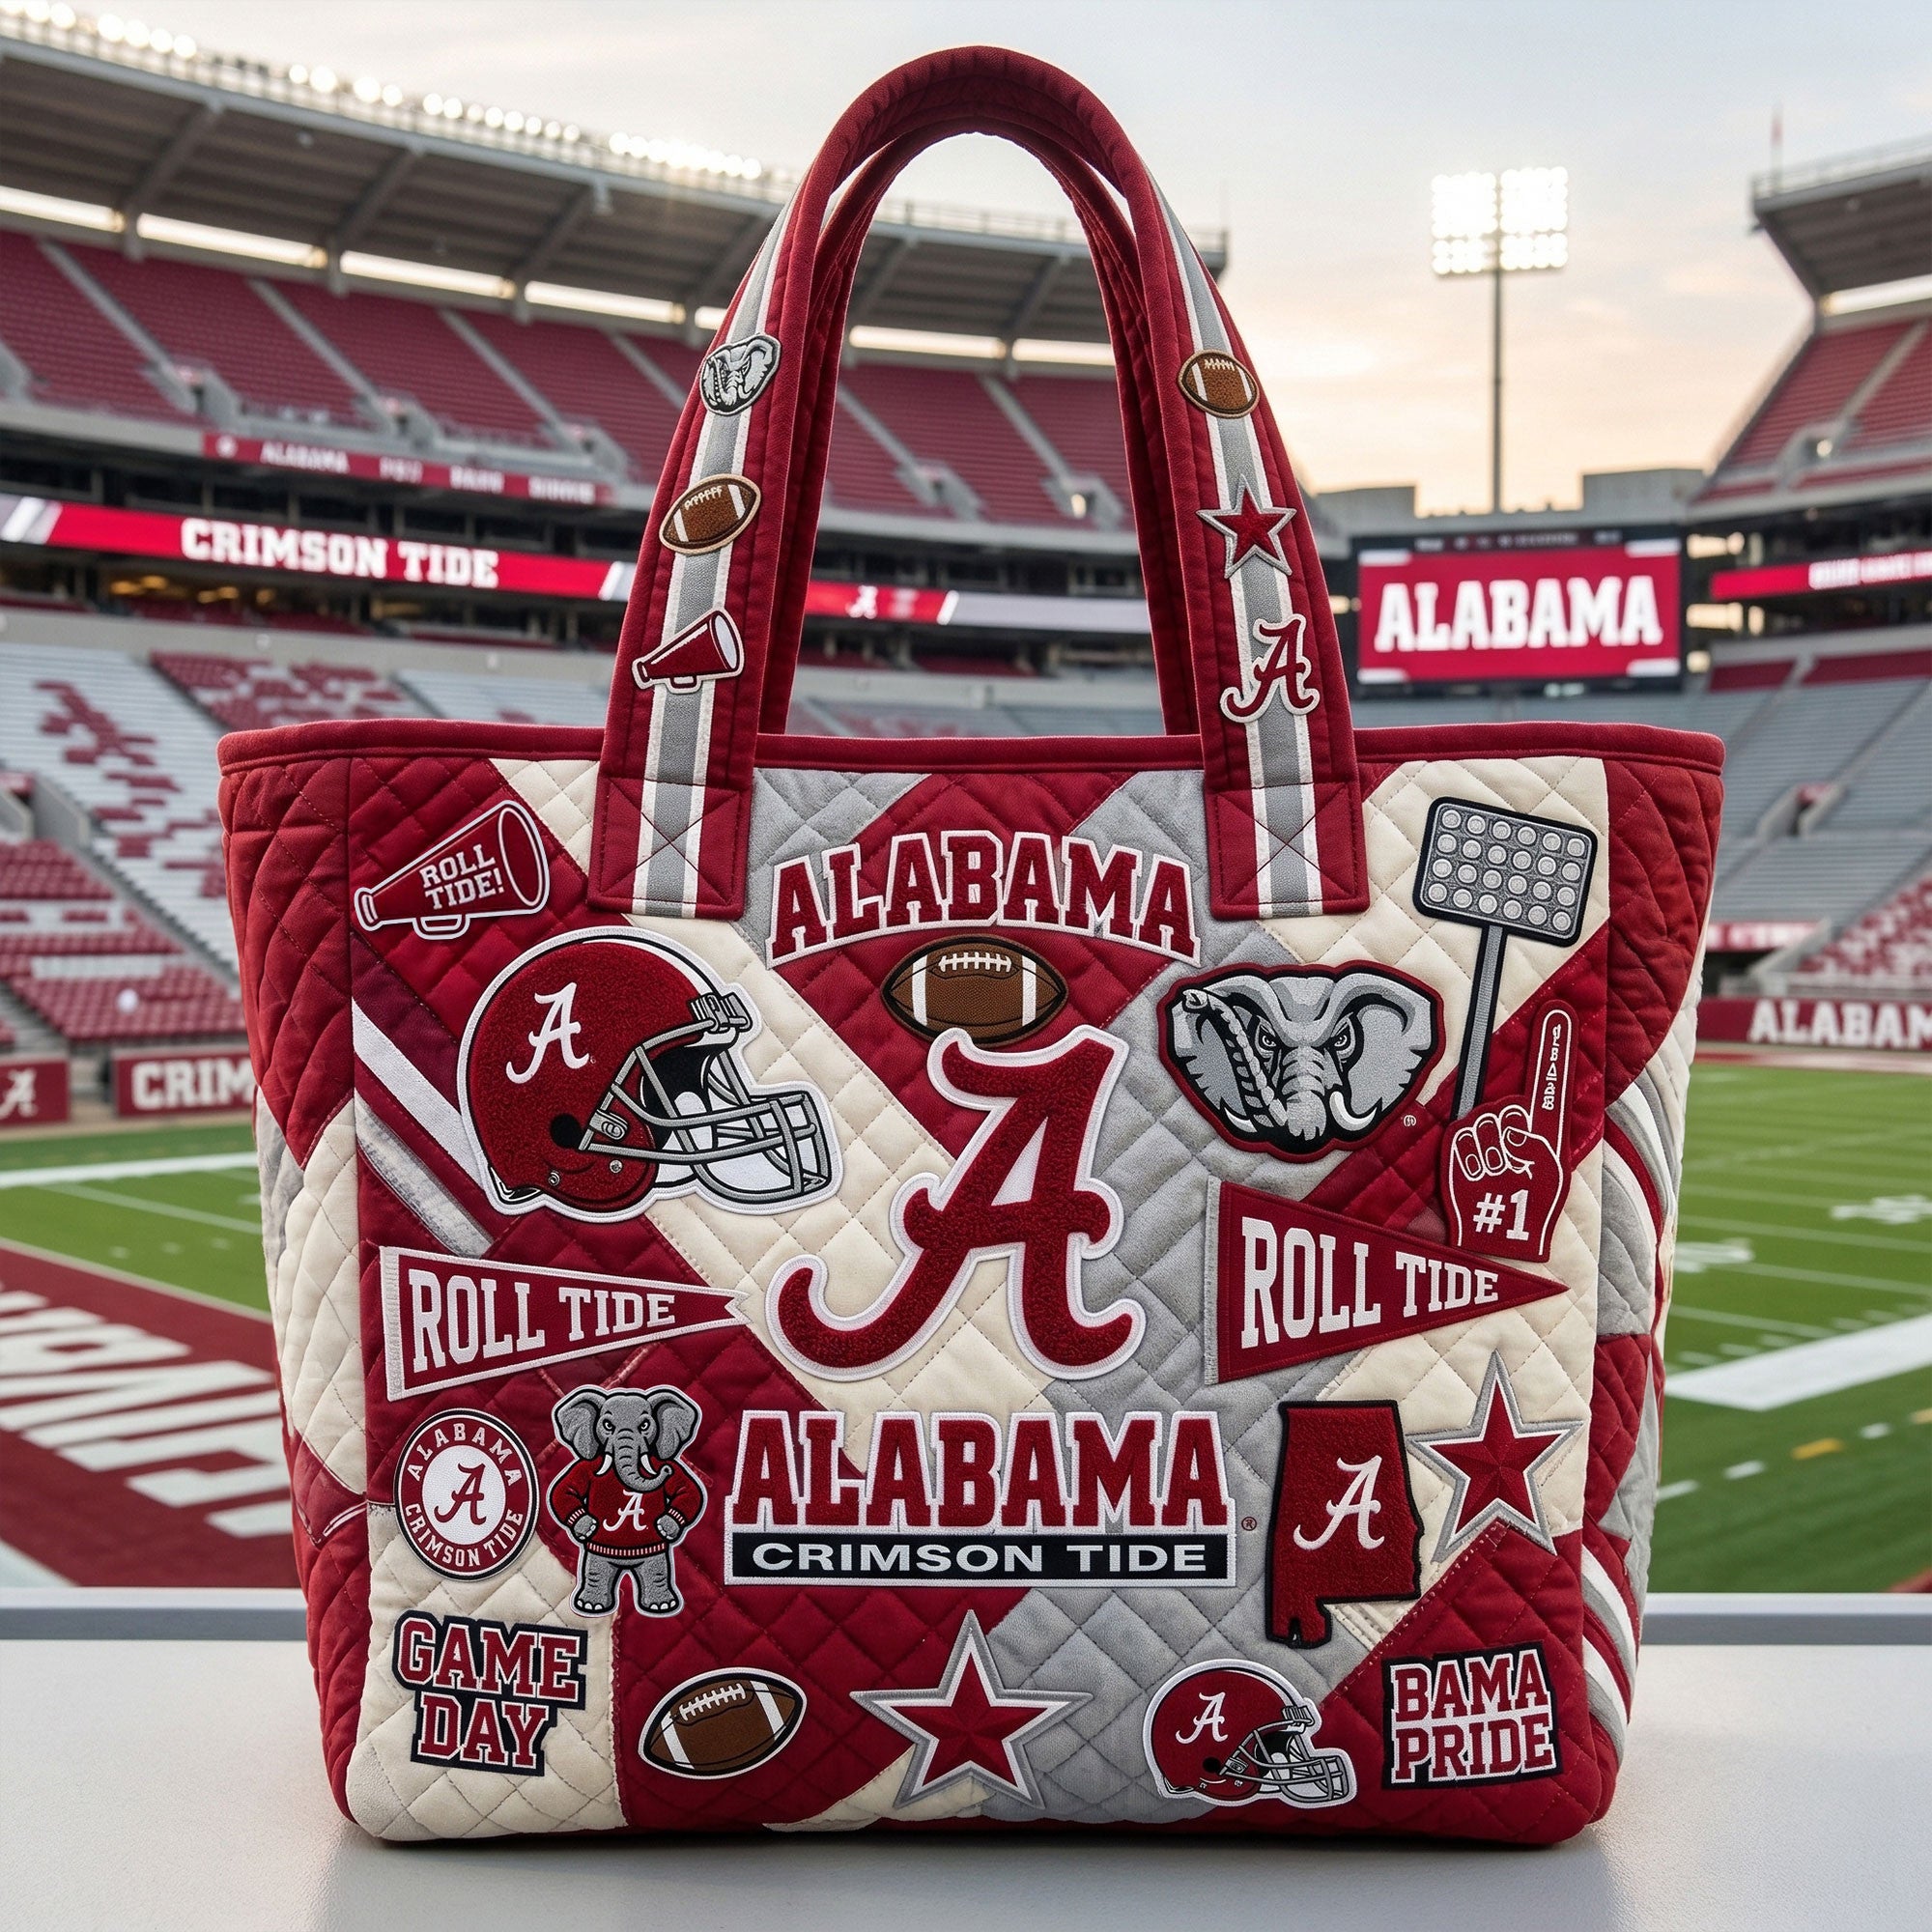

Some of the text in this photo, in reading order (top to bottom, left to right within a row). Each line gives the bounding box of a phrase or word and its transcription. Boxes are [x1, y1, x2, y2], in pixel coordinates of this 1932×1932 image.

[181, 517, 498, 588] CRIMSON TIDE
[1374, 575, 1663, 652] ALABAMA
[1222, 614, 1319, 722] A
[419, 843, 496, 888] ROLL
[425, 868, 504, 909] TIDE!
[768, 832, 1200, 967] ALABAMA
[505, 982, 589, 1084] A
[769, 1028, 1143, 1378] A
[1472, 1189, 1530, 1241] #1
[1241, 1216, 1498, 1349] ROLL TIDE
[409, 1268, 676, 1374] ROLL TIDE
[407, 1423, 522, 1487] ALABAMA
[728, 1413, 1232, 1529] ALABAMA
[434, 1463, 487, 1525] A
[603, 1491, 644, 1531] A
[1293, 1455, 1384, 1550] A
[406, 1503, 524, 1567] CRIMSON TIDE
[753, 1543, 1208, 1573] CRIMSON TIDE
[397, 1617, 580, 1703] GAME
[1390, 1649, 1549, 1722] BAMA
[417, 1692, 549, 1769] DAY
[1176, 1691, 1228, 1744] A
[1391, 1713, 1557, 1784] PRIDE
